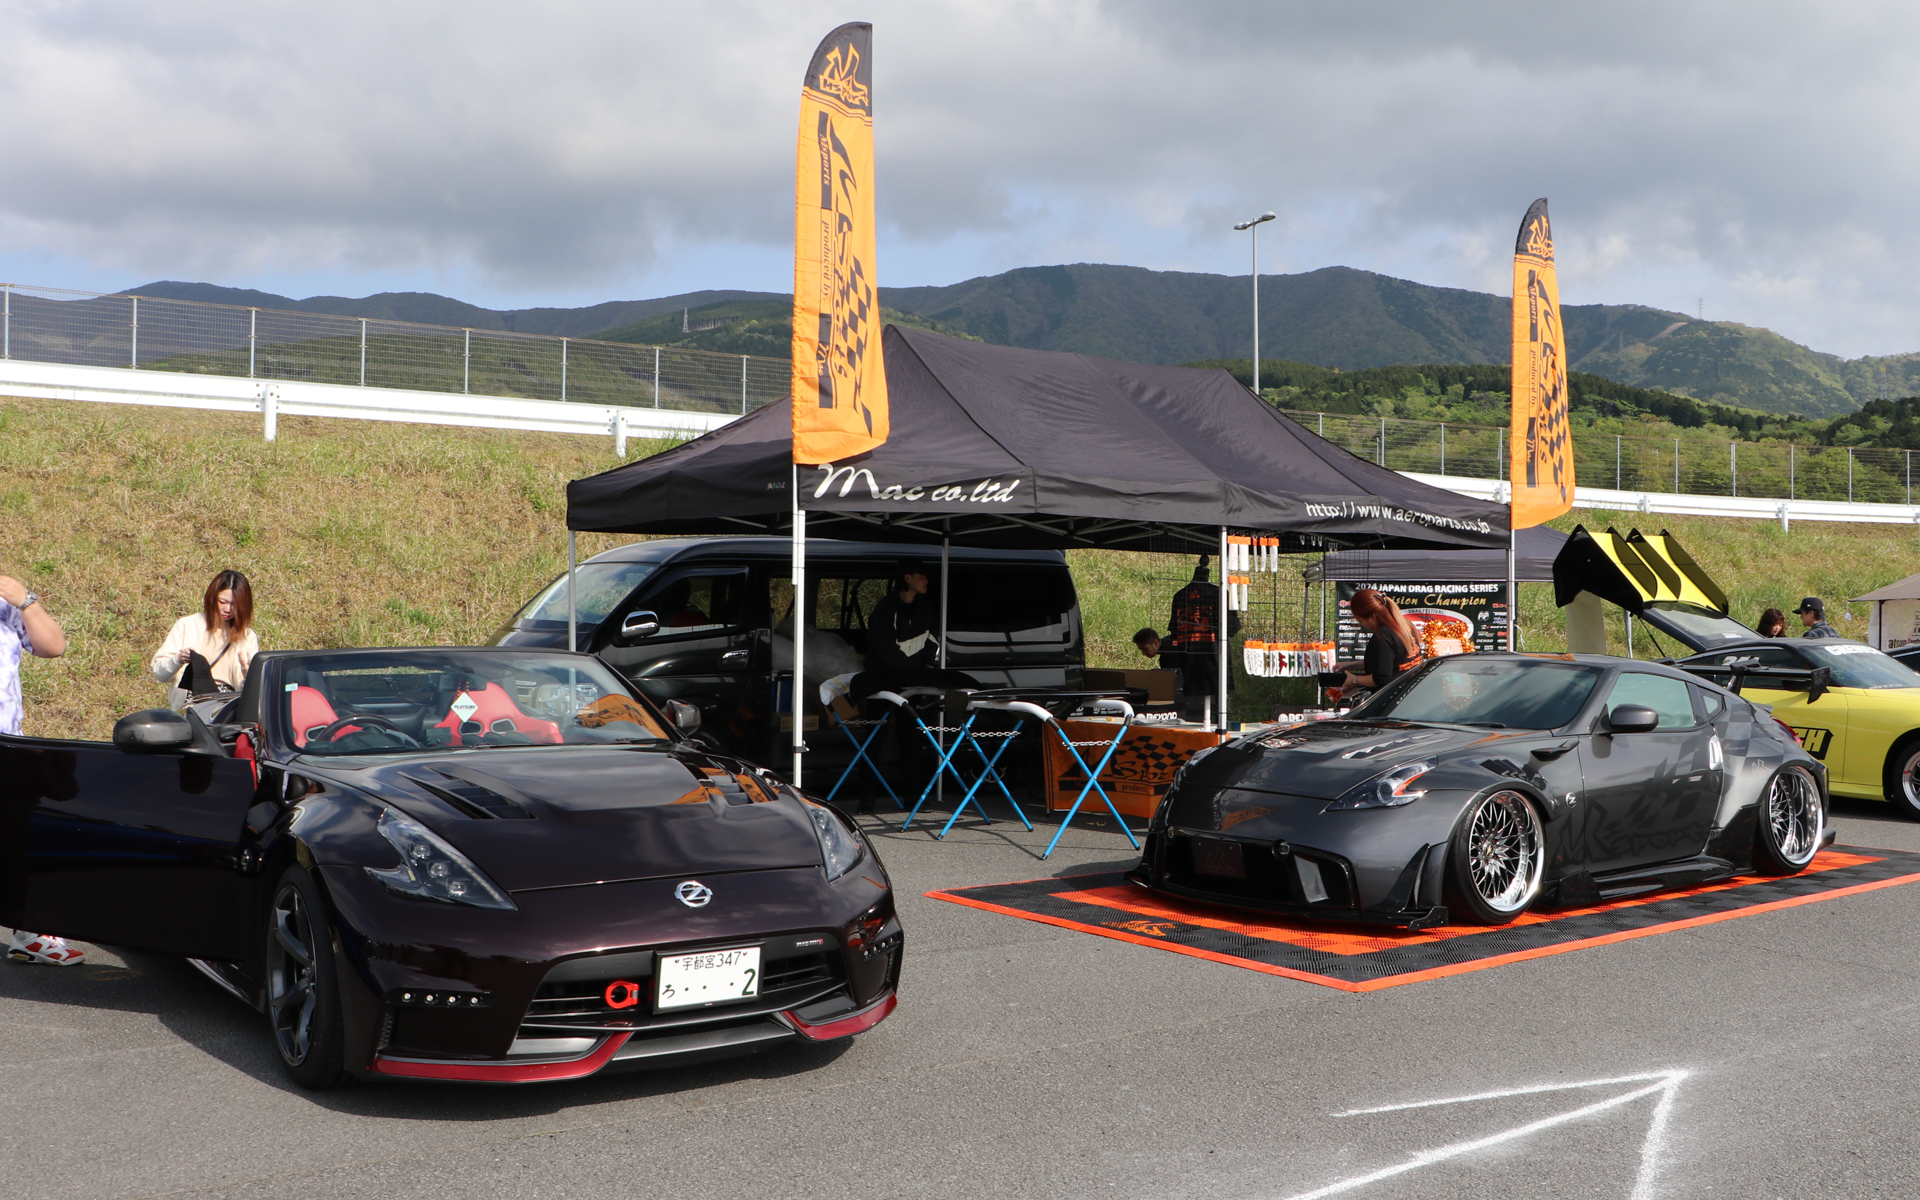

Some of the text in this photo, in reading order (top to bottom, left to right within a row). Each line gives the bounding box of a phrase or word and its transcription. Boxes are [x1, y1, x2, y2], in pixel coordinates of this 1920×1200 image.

[821, 220, 831, 281] produced
[814, 463, 1021, 503] Mac co.ltd
[1379, 584, 1406, 592] JAPAN
[1408, 584, 1433, 593] DRAG
[1435, 584, 1468, 593] RACING
[1469, 583, 1499, 593] SERIES
[1423, 593, 1487, 610] Champion
[1146, 712, 1178, 721] BEYOND
